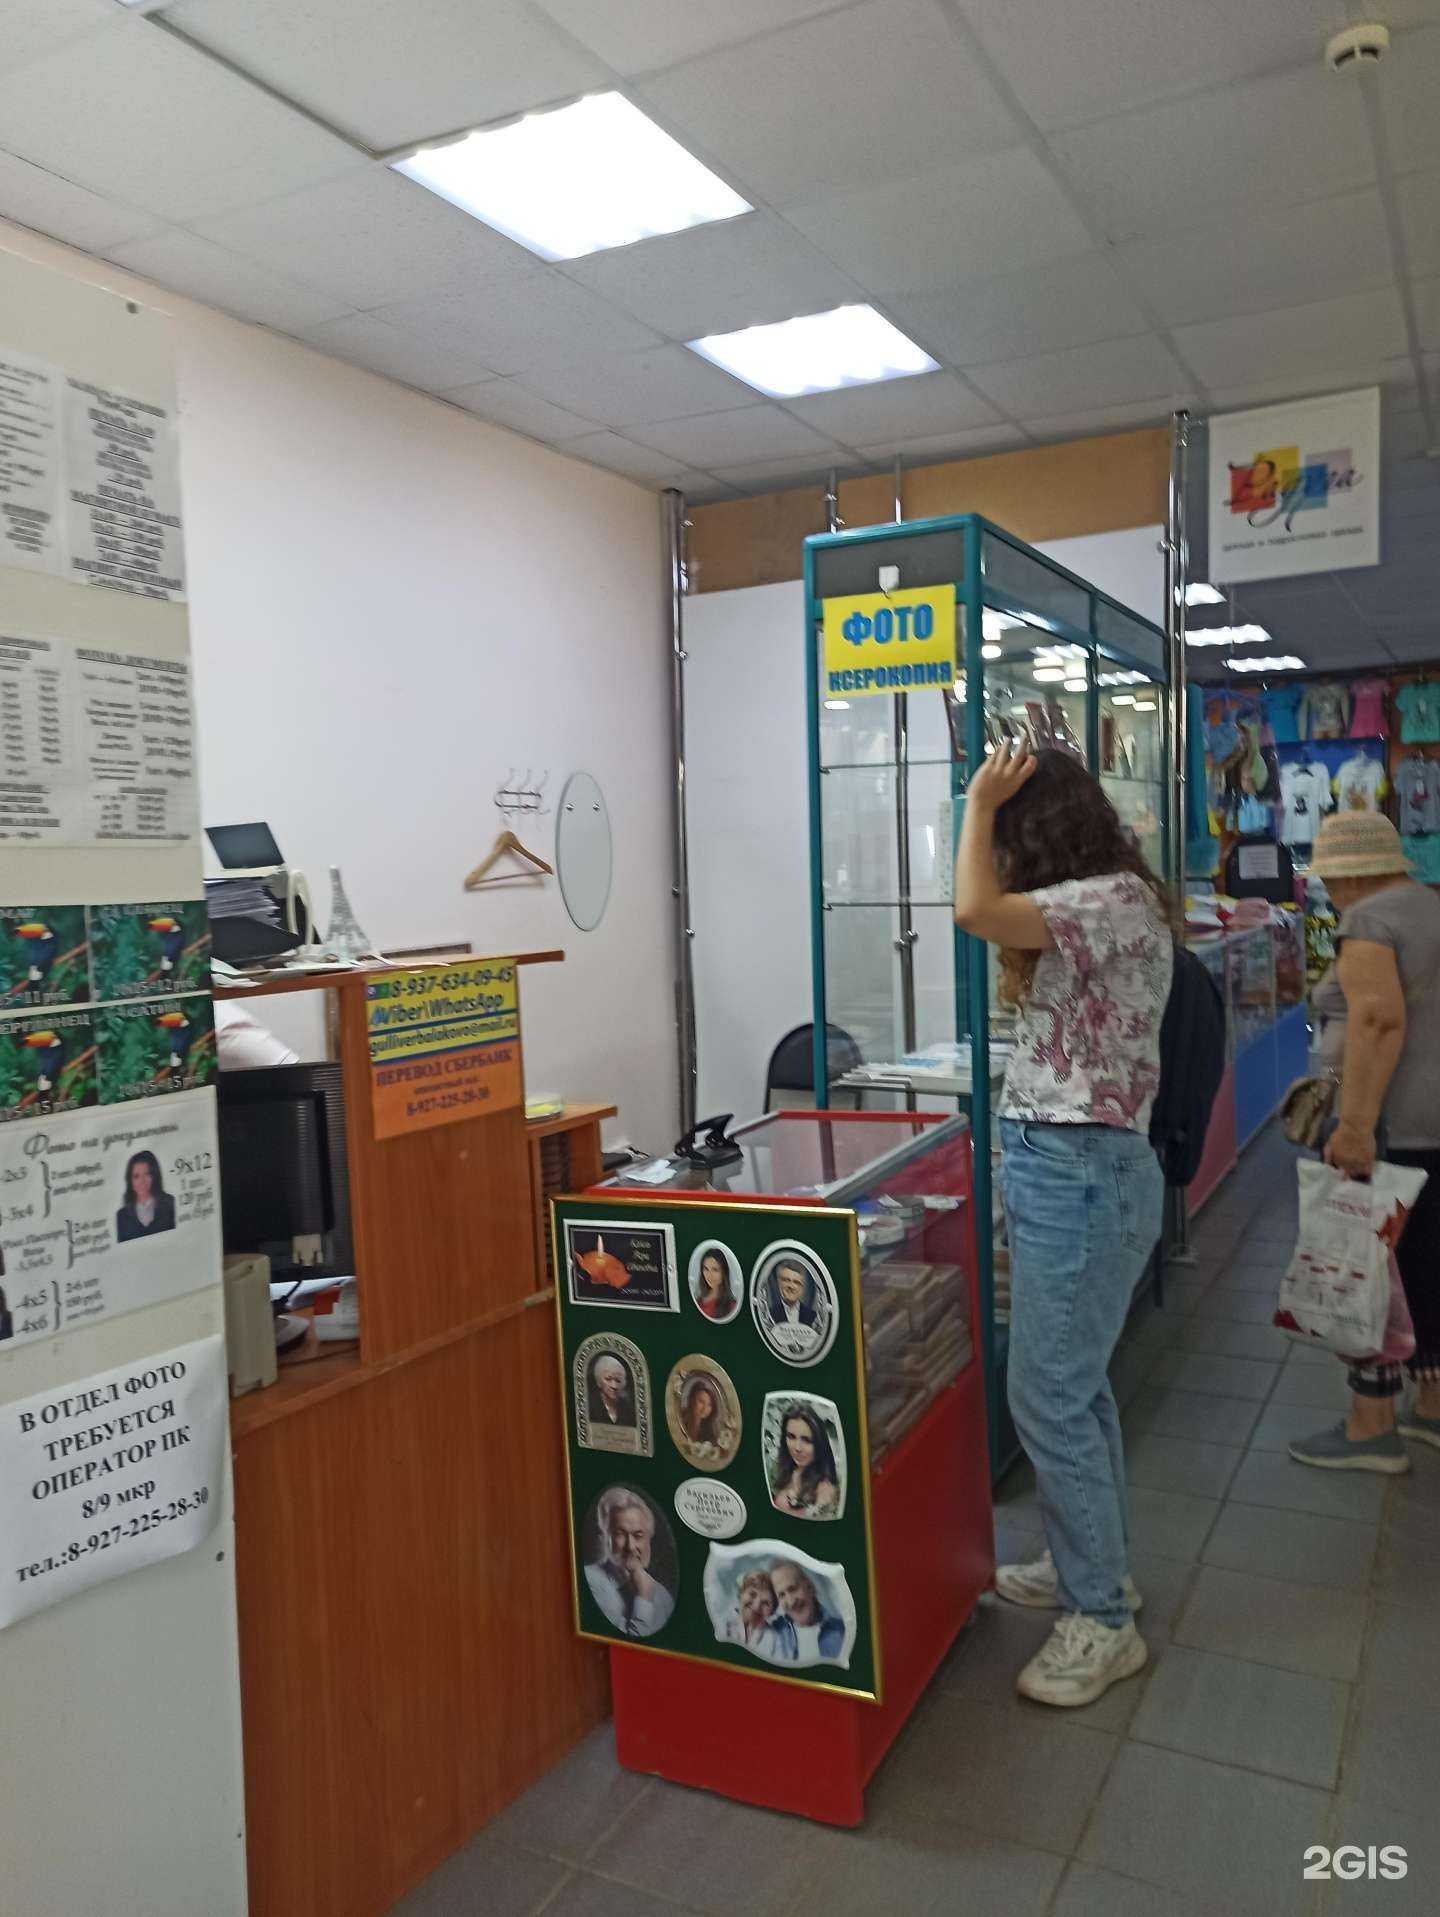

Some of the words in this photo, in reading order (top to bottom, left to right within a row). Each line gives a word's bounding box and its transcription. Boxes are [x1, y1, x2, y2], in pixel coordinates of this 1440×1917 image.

[842, 604, 933, 646] ФОТО
[828, 661, 952, 692] КСЕРОКОПИЯ
[391, 966, 513, 998] 8-937-634-09-45
[376, 1061, 443, 1087] ПЕРЕВОД
[445, 1049, 512, 1073] СБЕРБАНК
[22, 1132, 77, 1159] Фото
[19, 1412, 36, 1433] В
[40, 1383, 121, 1424] ОТДЕЛ
[124, 1361, 187, 1394] ФОТО
[43, 1399, 176, 1461] ТРЕБУЕТСЯ
[32, 1439, 157, 1500] ОПЕРАТОР
[162, 1425, 192, 1451] ПК
[81, 1493, 112, 1519] 8/9
[117, 1479, 156, 1507] мкр
